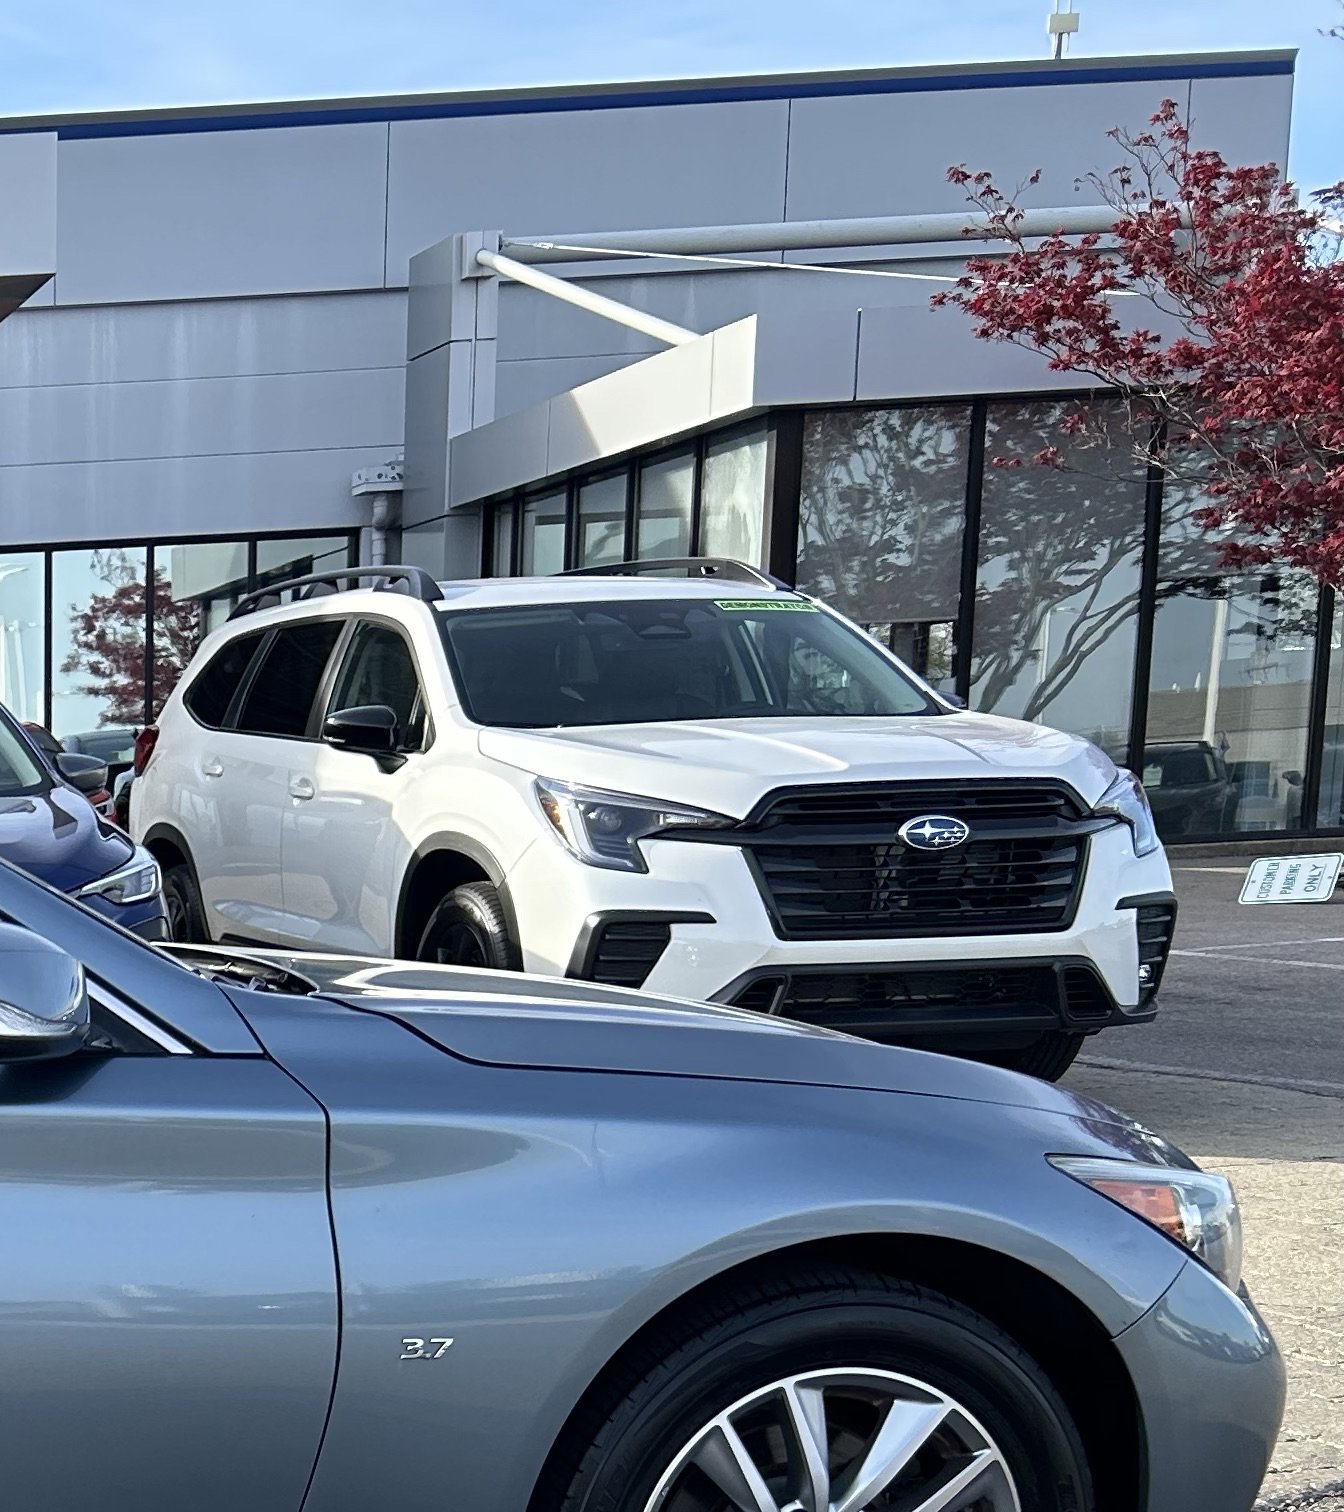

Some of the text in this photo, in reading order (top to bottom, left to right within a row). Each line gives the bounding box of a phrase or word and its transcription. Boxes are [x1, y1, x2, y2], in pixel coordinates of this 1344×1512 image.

[1280, 863, 1302, 895] PARKING
[1304, 864, 1323, 893] ONLY
[400, 1338, 454, 1360] 3.7
